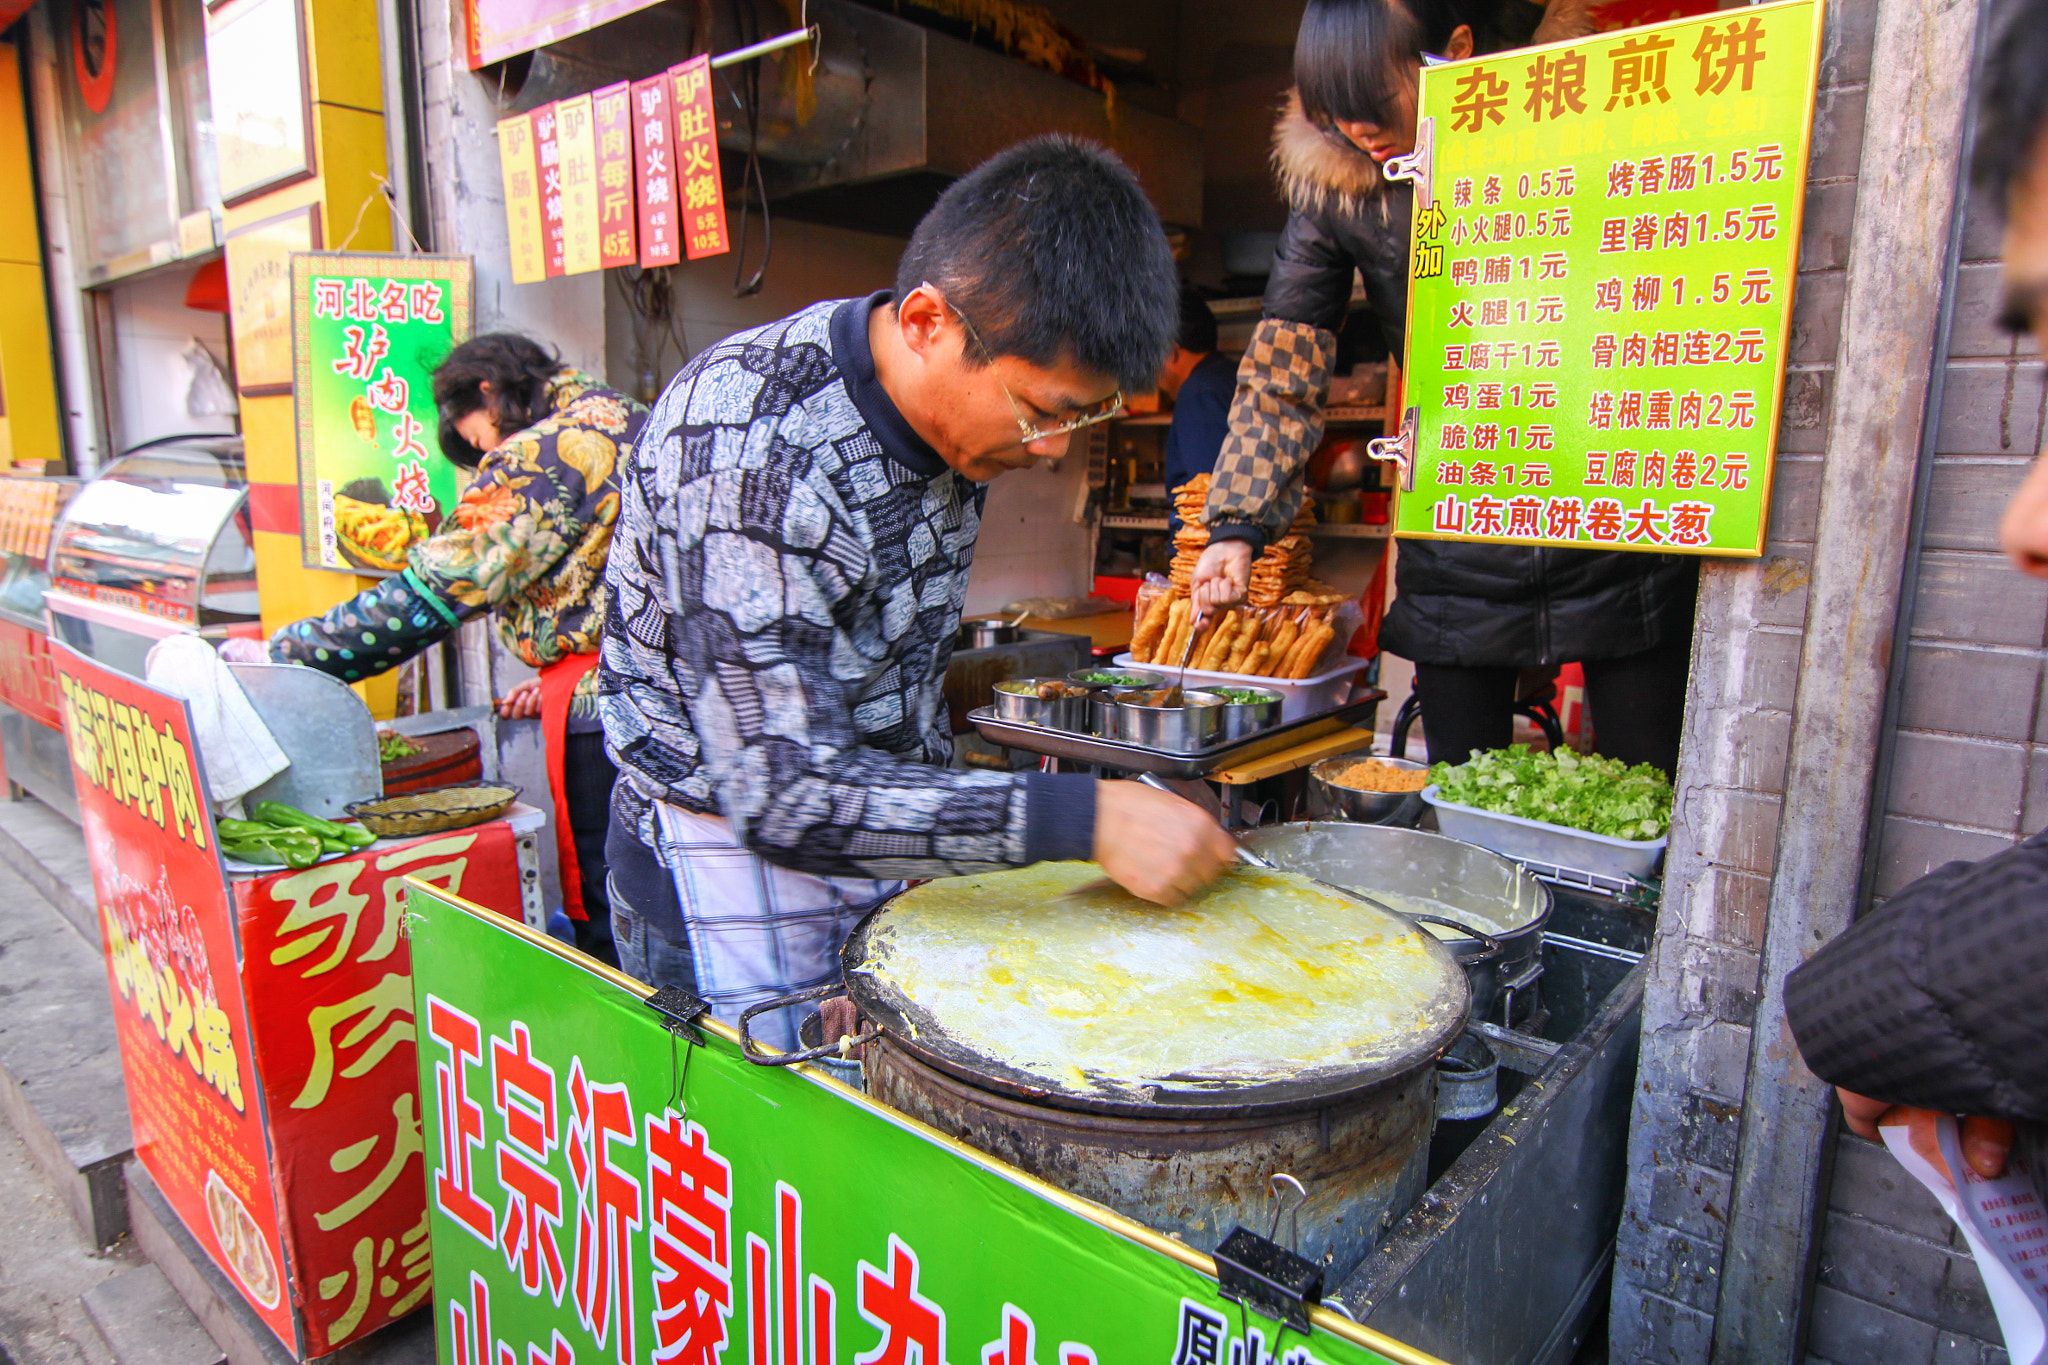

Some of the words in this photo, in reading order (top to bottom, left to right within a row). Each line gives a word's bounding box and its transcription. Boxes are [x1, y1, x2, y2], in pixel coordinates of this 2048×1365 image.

[1450, 17, 1767, 134] 杂粮煎饼
[640, 86, 669, 205] 驴肉火烧
[674, 69, 718, 210] 驴肚火烧
[1453, 175, 1502, 209] 辣条
[1518, 167, 1576, 200] 0.5元
[1606, 144, 1783, 199] 烤香肠1.5元
[603, 229, 630, 257] 45元
[692, 231, 721, 250] 10元
[1415, 201, 1446, 278] 外加
[1450, 208, 1571, 248] 小火腿0.5元
[1598, 204, 1778, 254] 里脊肉1.5元
[1450, 252, 1568, 287] 鸭脯1元
[315, 278, 444, 323] 河北名吃
[1594, 269, 1772, 313] 鸡柳1.5元
[1448, 297, 1564, 329] 火腿1元
[1443, 341, 1561, 371] 豆腐干1元
[1590, 328, 1766, 369] 骨肉相连2元
[1442, 382, 1558, 411] 鸡蛋1元
[1587, 390, 1757, 432] 培根熏肉2元
[333, 324, 435, 513] 驴肉火烧
[1440, 423, 1556, 452] 脆饼1元
[1436, 461, 1552, 488] 油条1元
[1582, 450, 1751, 491] 豆腐肉卷2元
[1433, 494, 1713, 547] 山东煎饼卷大葱
[59, 670, 206, 851] 正宗河间驴肉
